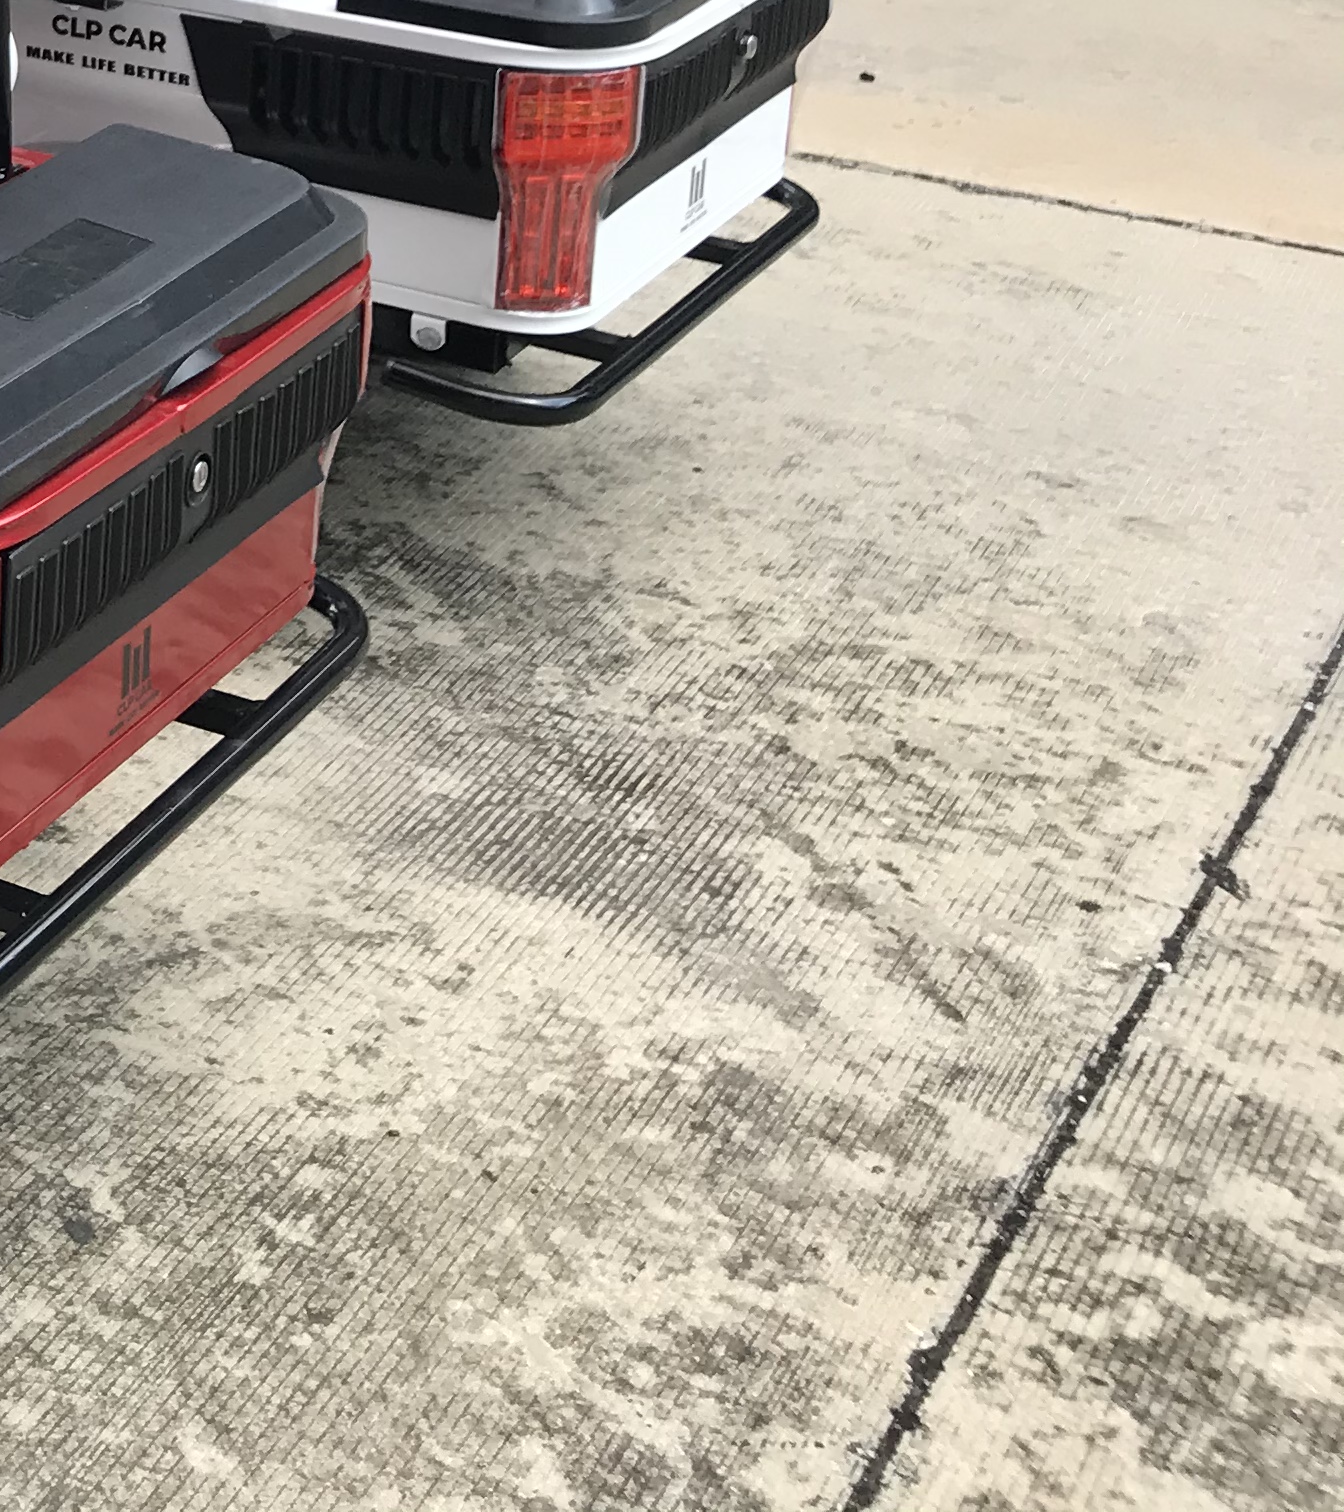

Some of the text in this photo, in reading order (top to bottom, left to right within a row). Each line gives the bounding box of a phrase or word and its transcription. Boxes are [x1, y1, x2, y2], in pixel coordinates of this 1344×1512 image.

[52, 14, 167, 54] CLP CAR
[26, 45, 190, 86] MAKE LIFE BETTER
